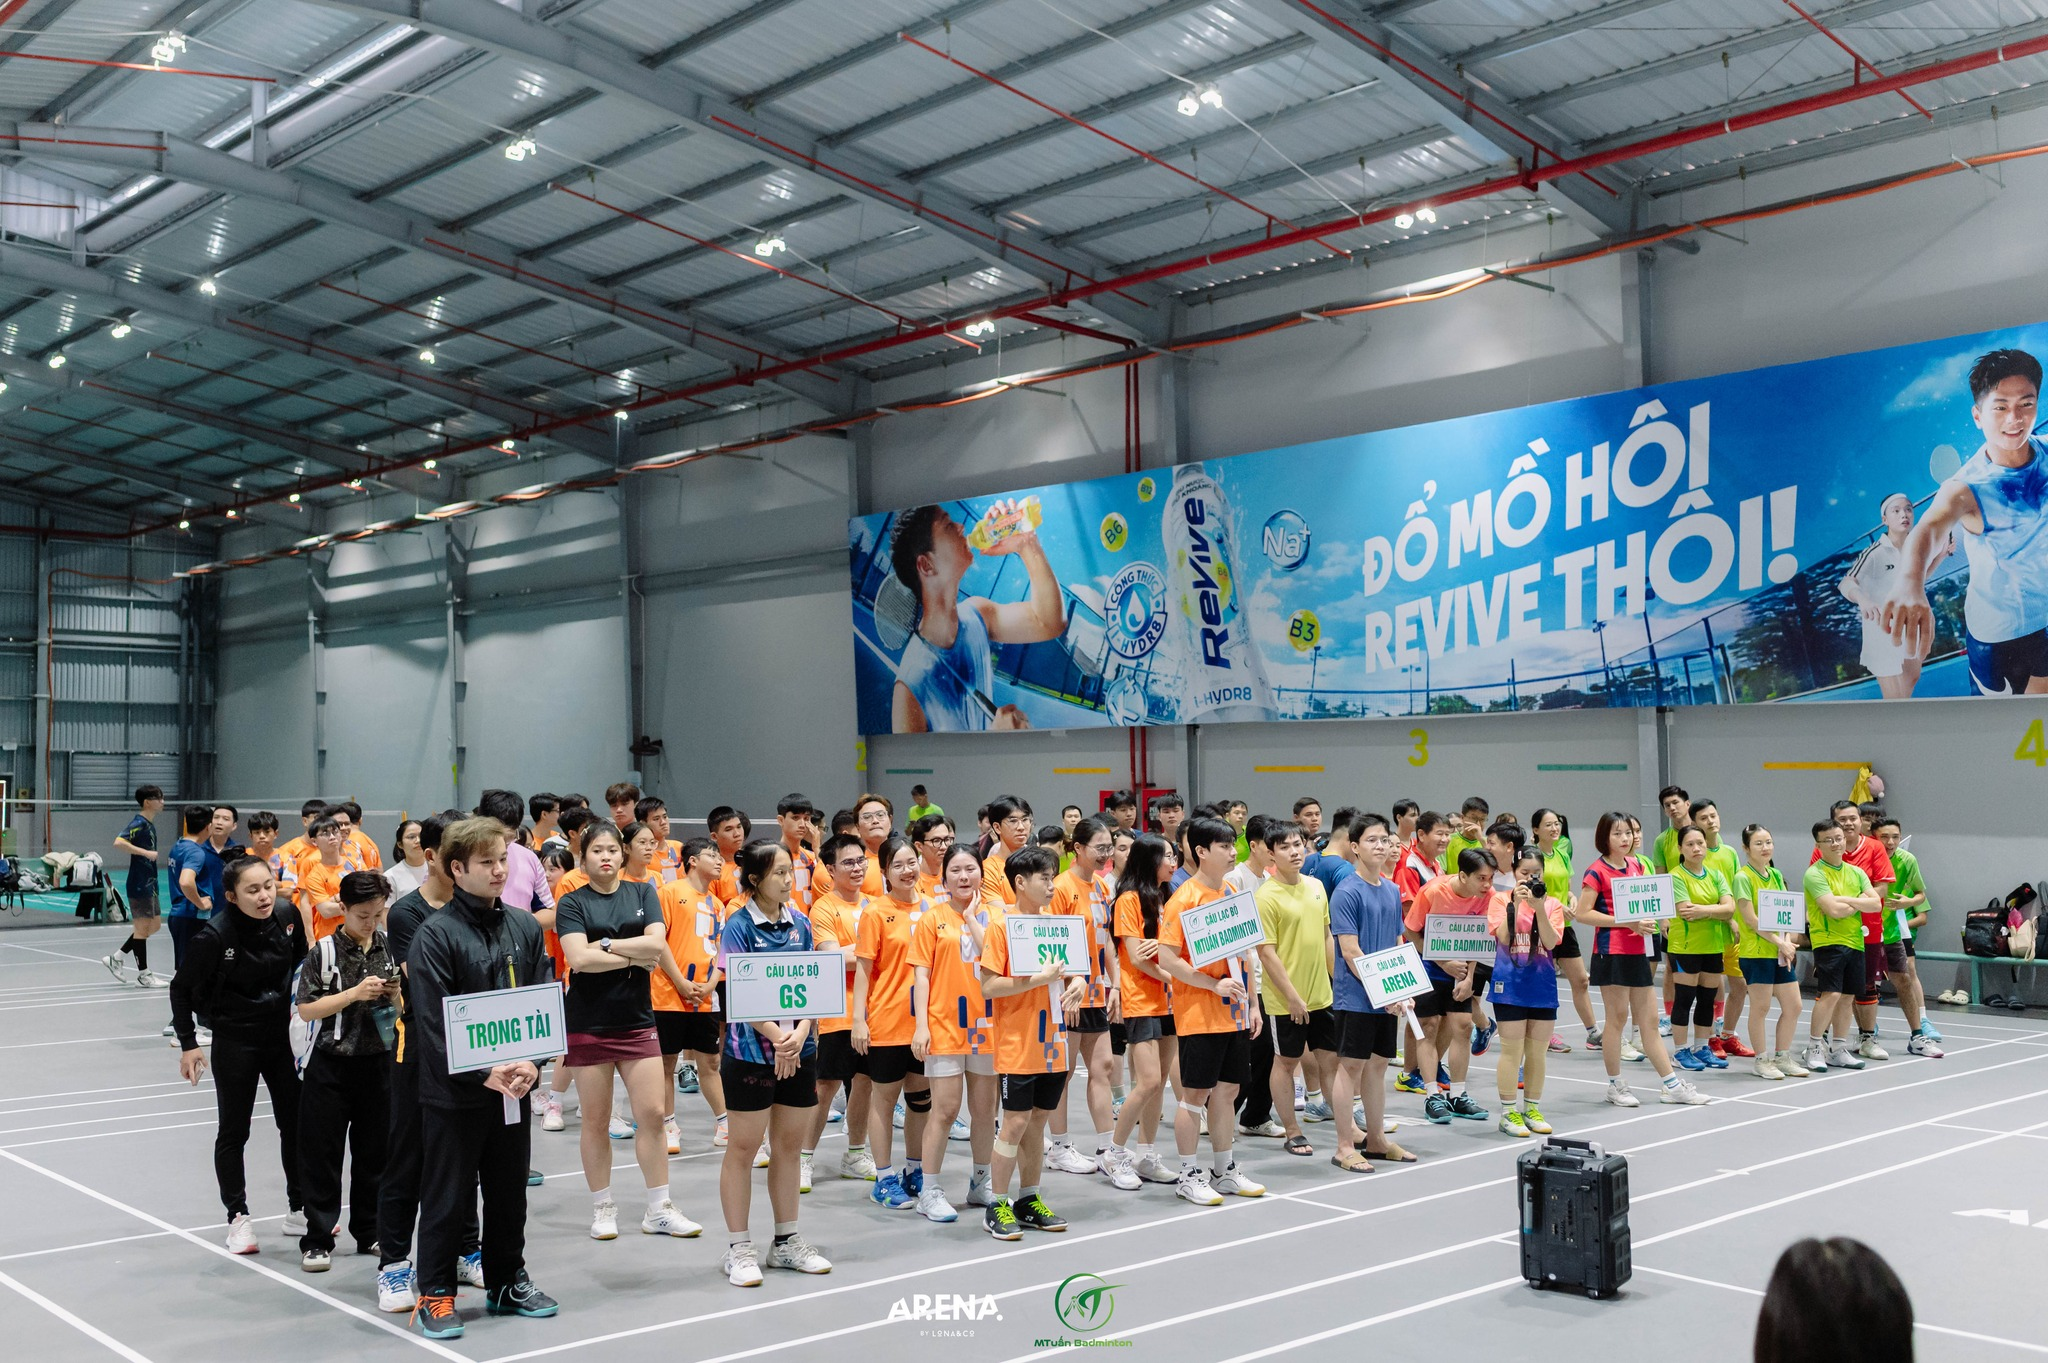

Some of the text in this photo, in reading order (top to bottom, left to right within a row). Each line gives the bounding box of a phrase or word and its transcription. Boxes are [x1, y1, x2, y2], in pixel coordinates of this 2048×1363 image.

[1362, 399, 1710, 597] ĐỔ MỒ HÔI
[1105, 520, 1123, 544] B6
[1110, 569, 1159, 604] CÔNG THỨC
[1365, 485, 1799, 674] REVIVE THÔI!
[1290, 618, 1316, 642] B3
[1408, 728, 1429, 767] 3
[2013, 719, 2048, 767] 4
[855, 742, 867, 771] 2
[1205, 903, 1239, 926] CÂU LẠC BỘ
[1628, 896, 1661, 915] UY VIỆT
[1777, 910, 1792, 925] ACE
[1033, 924, 1070, 940] CÂU LẠC BỘ
[1218, 918, 1259, 947] BADMINTON
[1449, 922, 1486, 934] CÂU LẠC BỘ
[1431, 936, 1452, 951] DŨNG
[1453, 939, 1497, 952] BADMINTON
[766, 961, 819, 980] CÂU LẠC BỘ
[1381, 970, 1418, 994] ARENA
[779, 983, 807, 1009] GS
[466, 1009, 551, 1051] TRỌNG TÀI
